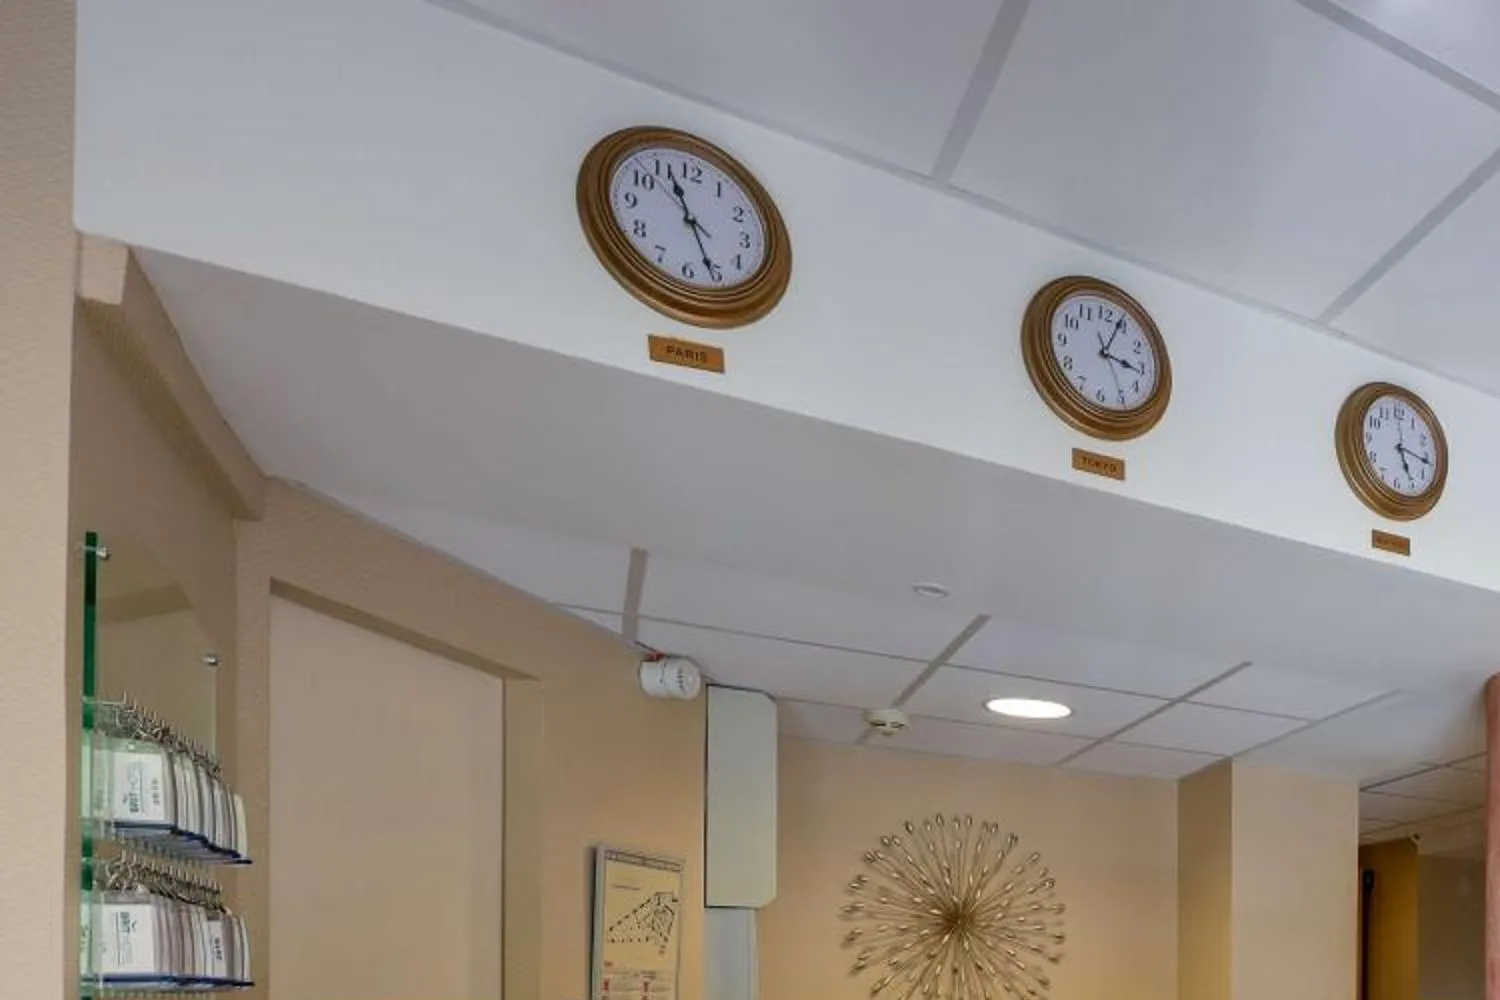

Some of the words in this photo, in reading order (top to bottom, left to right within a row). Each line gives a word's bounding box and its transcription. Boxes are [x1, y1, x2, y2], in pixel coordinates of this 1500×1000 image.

[653, 159, 673, 181] 11
[681, 161, 703, 184] 12
[632, 169, 655, 191] 10
[715, 181, 723, 198] 1
[624, 191, 638, 209] 9
[732, 206, 745, 222] 2
[632, 219, 647, 239] 8
[739, 231, 751, 249] 3
[654, 244, 667, 264] 7
[681, 262, 695, 279] 6
[711, 264, 723, 283] 5
[1079, 303, 1092, 321] 11
[1098, 304, 1113, 323] 12
[1064, 313, 1080, 331] 10
[1057, 333, 1068, 346] 9
[1132, 340, 1142, 354] 2
[665, 344, 708, 365] PARIS
[1063, 355, 1073, 371] 8
